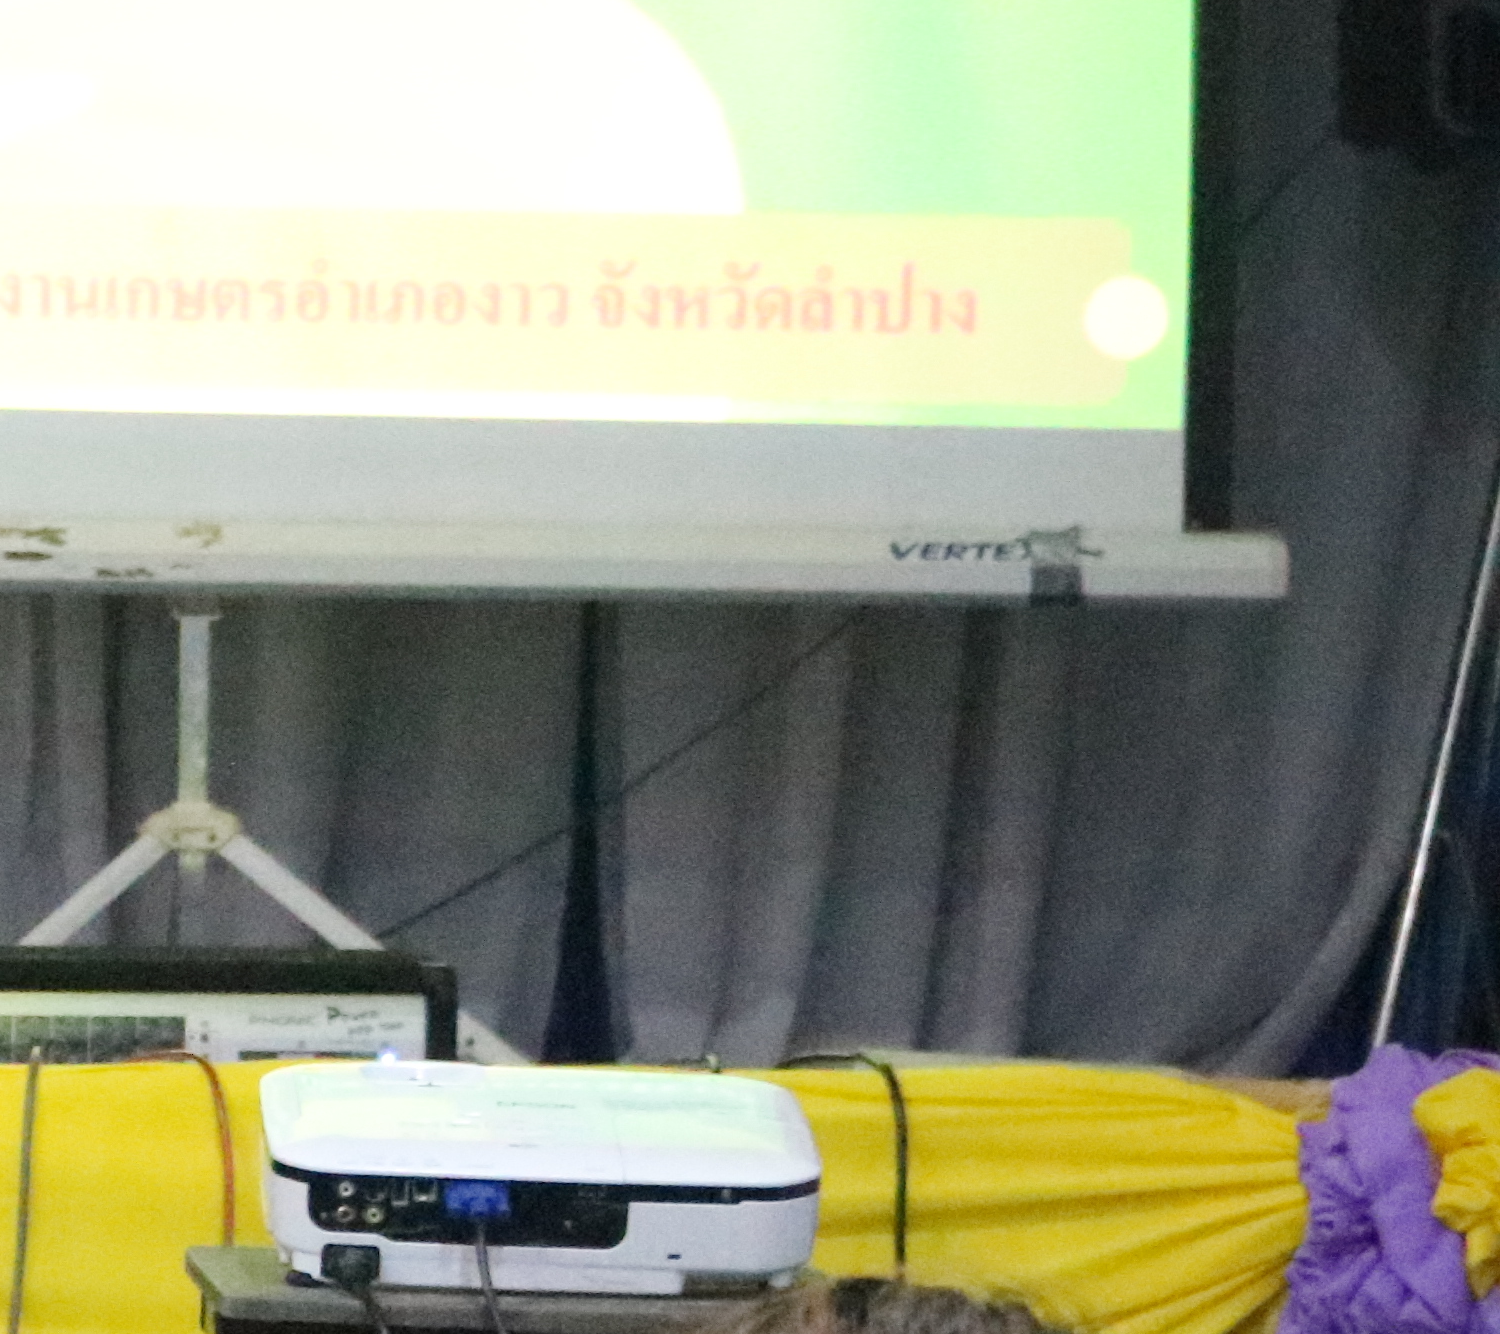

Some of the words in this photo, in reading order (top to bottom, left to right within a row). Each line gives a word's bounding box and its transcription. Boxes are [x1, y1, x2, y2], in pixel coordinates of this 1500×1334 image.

[590, 257, 979, 338] จังหวัดลำปาง
